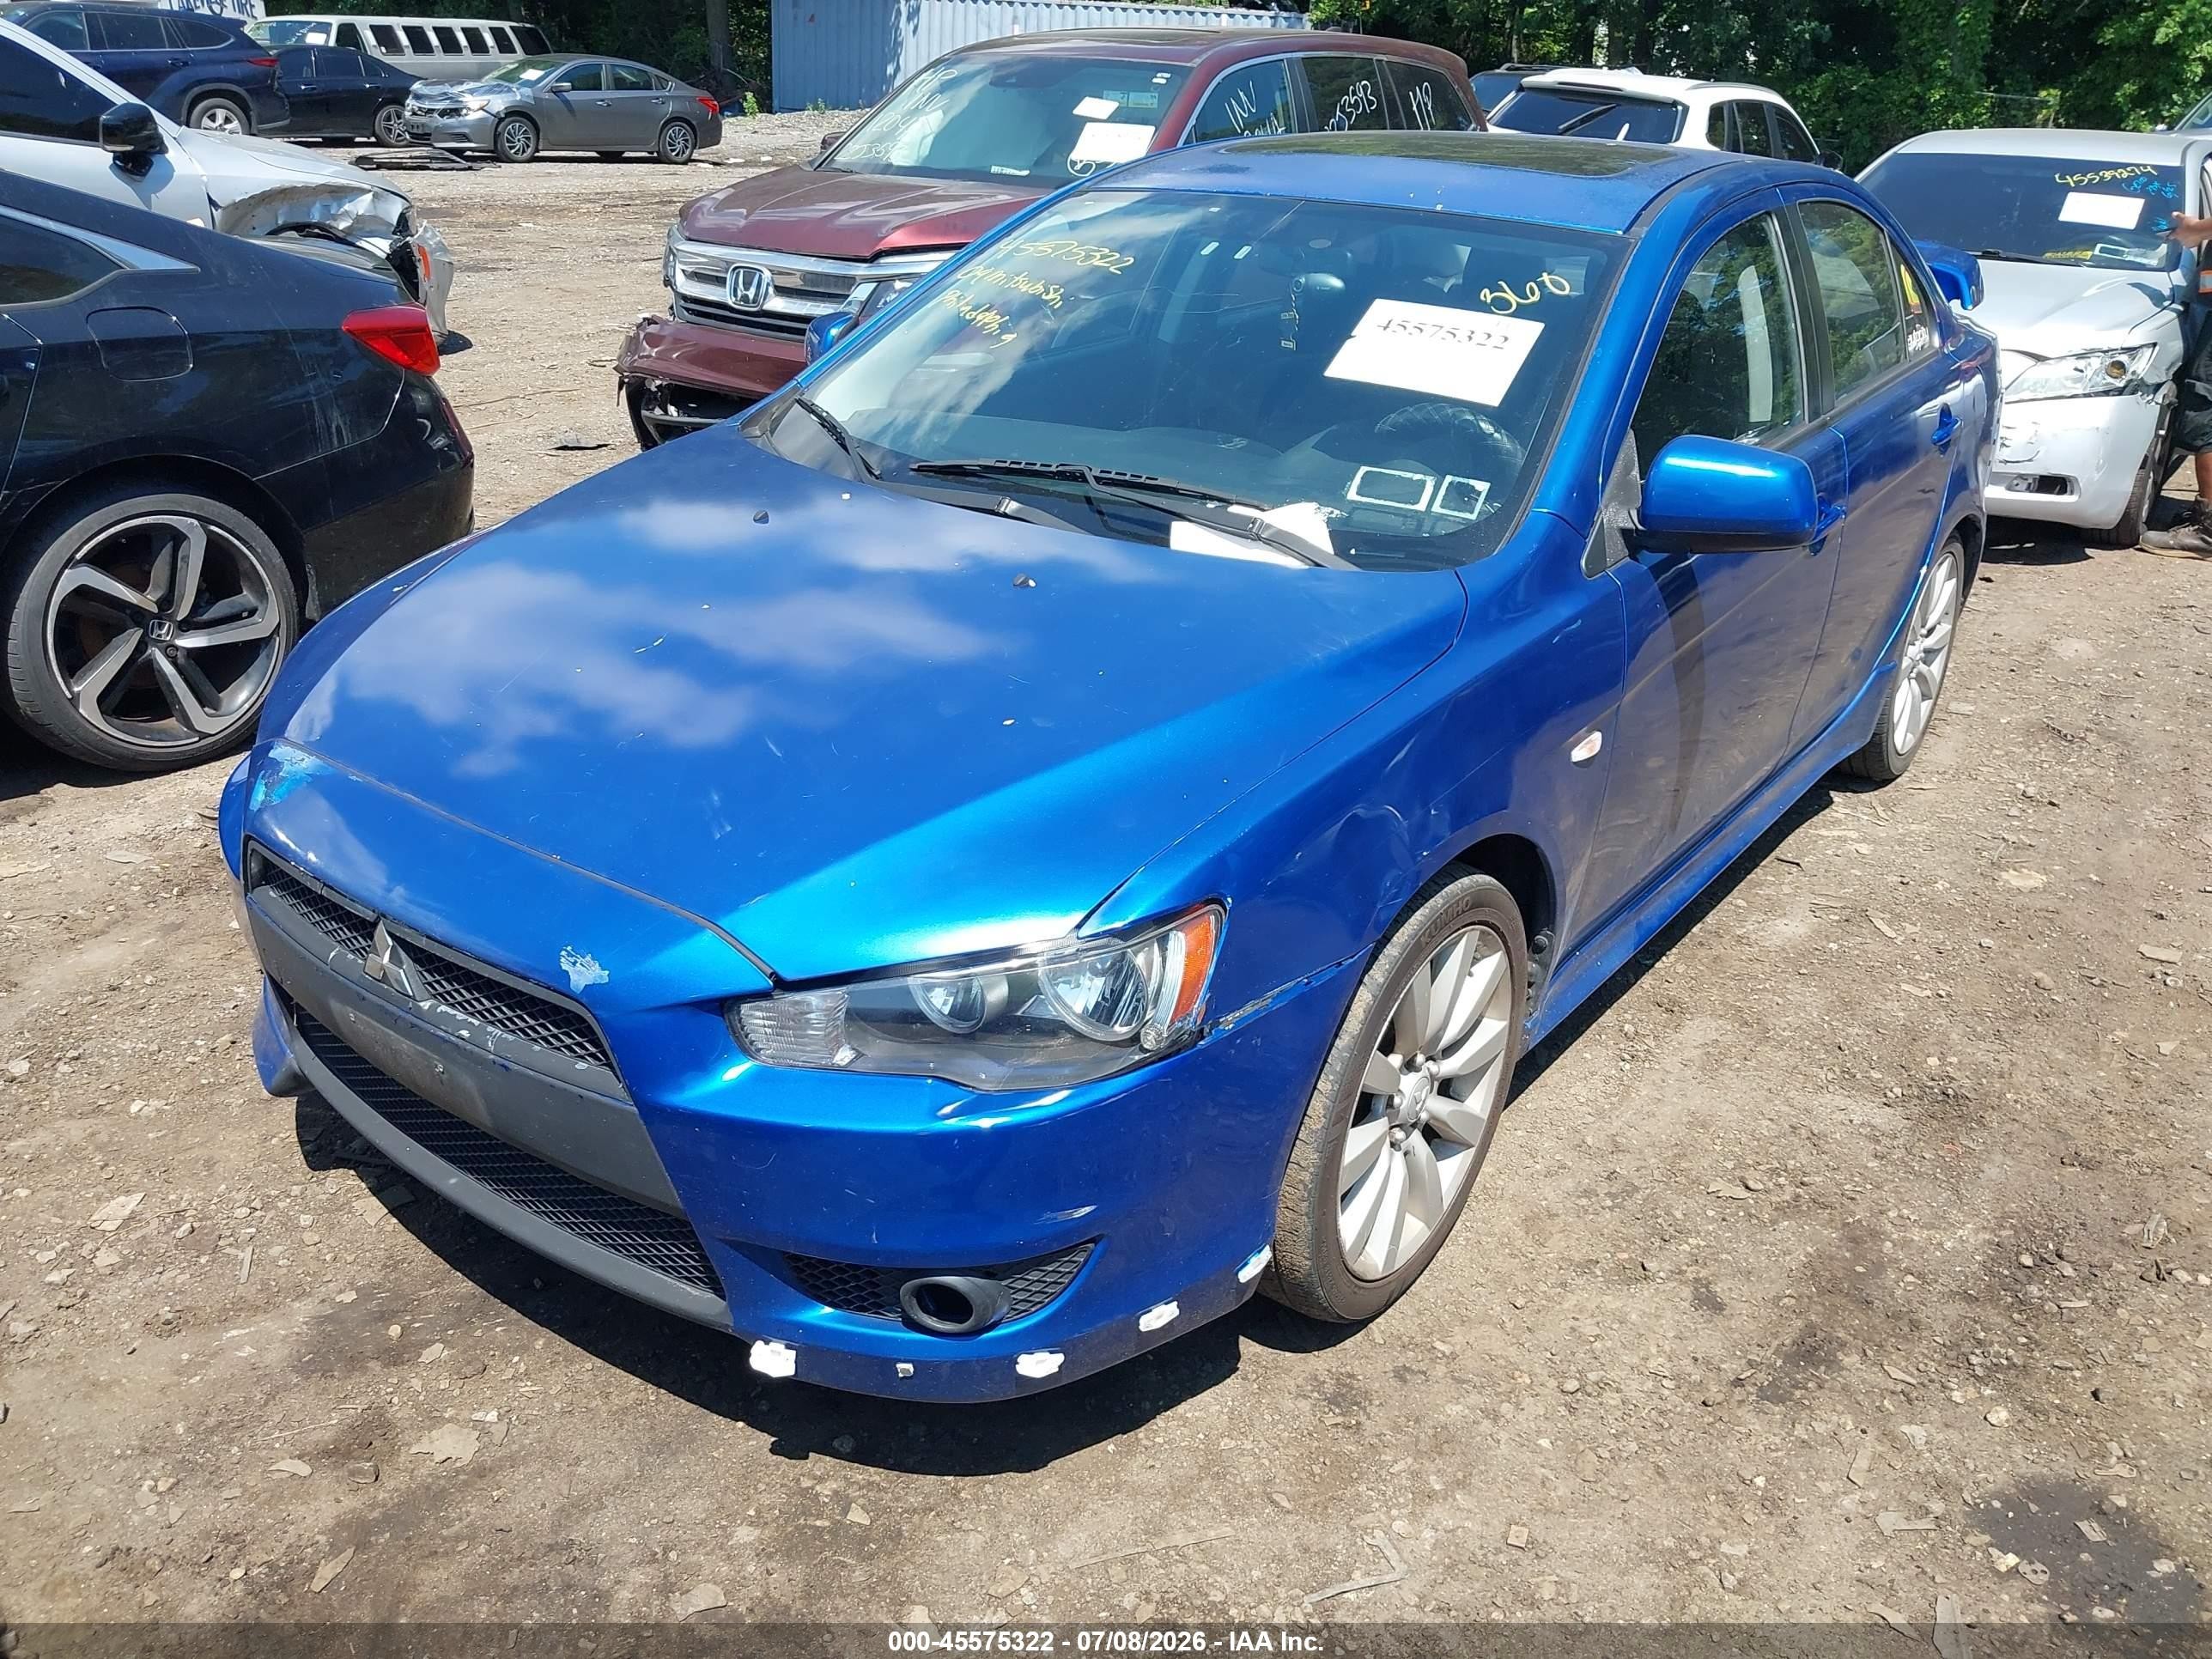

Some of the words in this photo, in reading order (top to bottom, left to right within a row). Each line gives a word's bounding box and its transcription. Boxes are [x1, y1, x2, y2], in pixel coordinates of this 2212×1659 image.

[2054, 165, 2158, 188] 45539274
[999, 239, 1135, 275] 45575322
[1480, 271, 1571, 314] 360
[1376, 317, 1511, 350] 45575322
